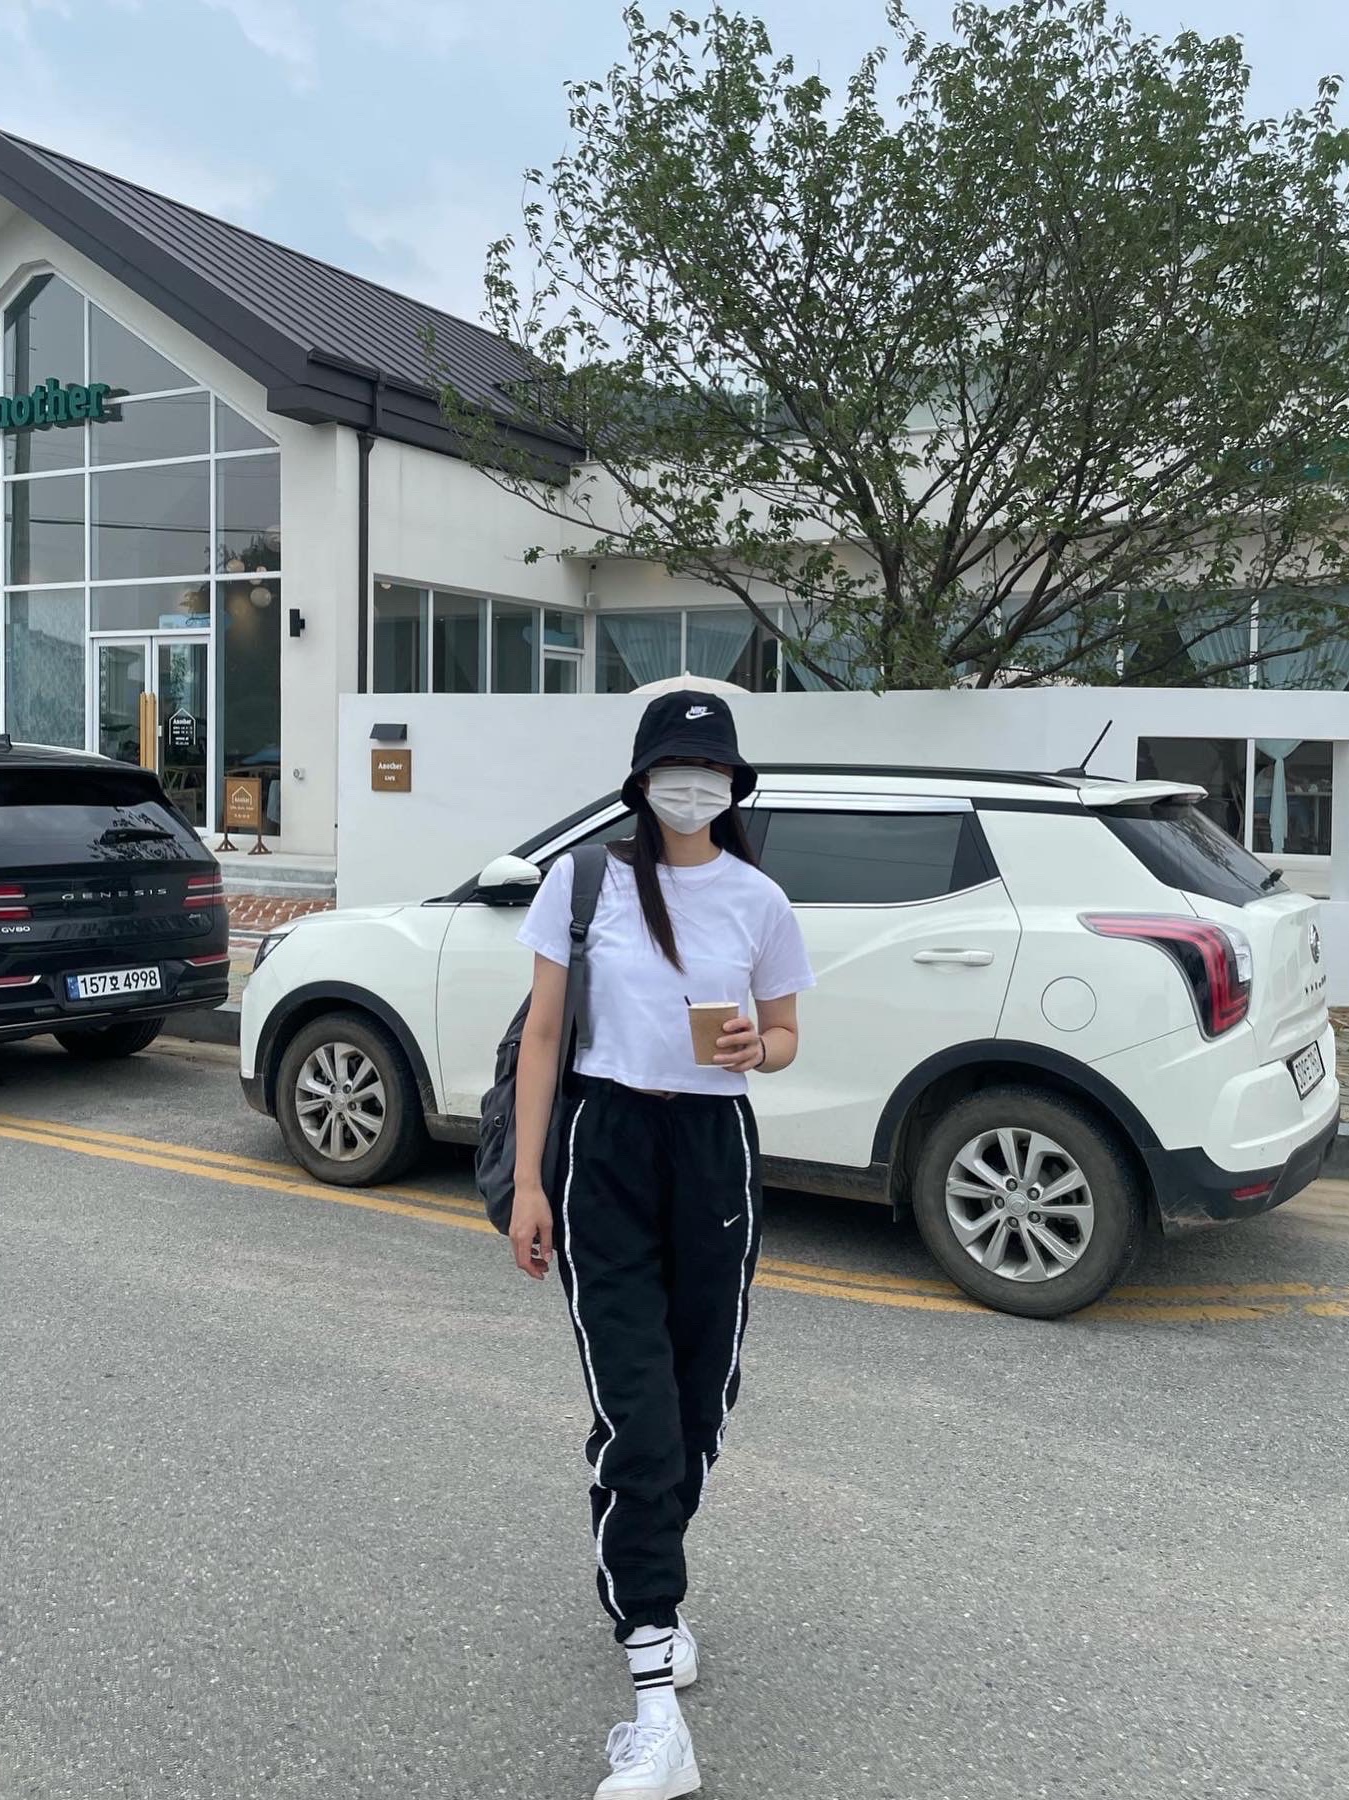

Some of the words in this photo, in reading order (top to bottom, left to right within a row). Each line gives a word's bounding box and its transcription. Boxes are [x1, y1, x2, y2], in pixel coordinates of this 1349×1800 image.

[689, 706, 708, 714] NIKE
[378, 762, 402, 770] Another
[62, 888, 167, 900] GENESIS
[124, 970, 157, 989] 4998
